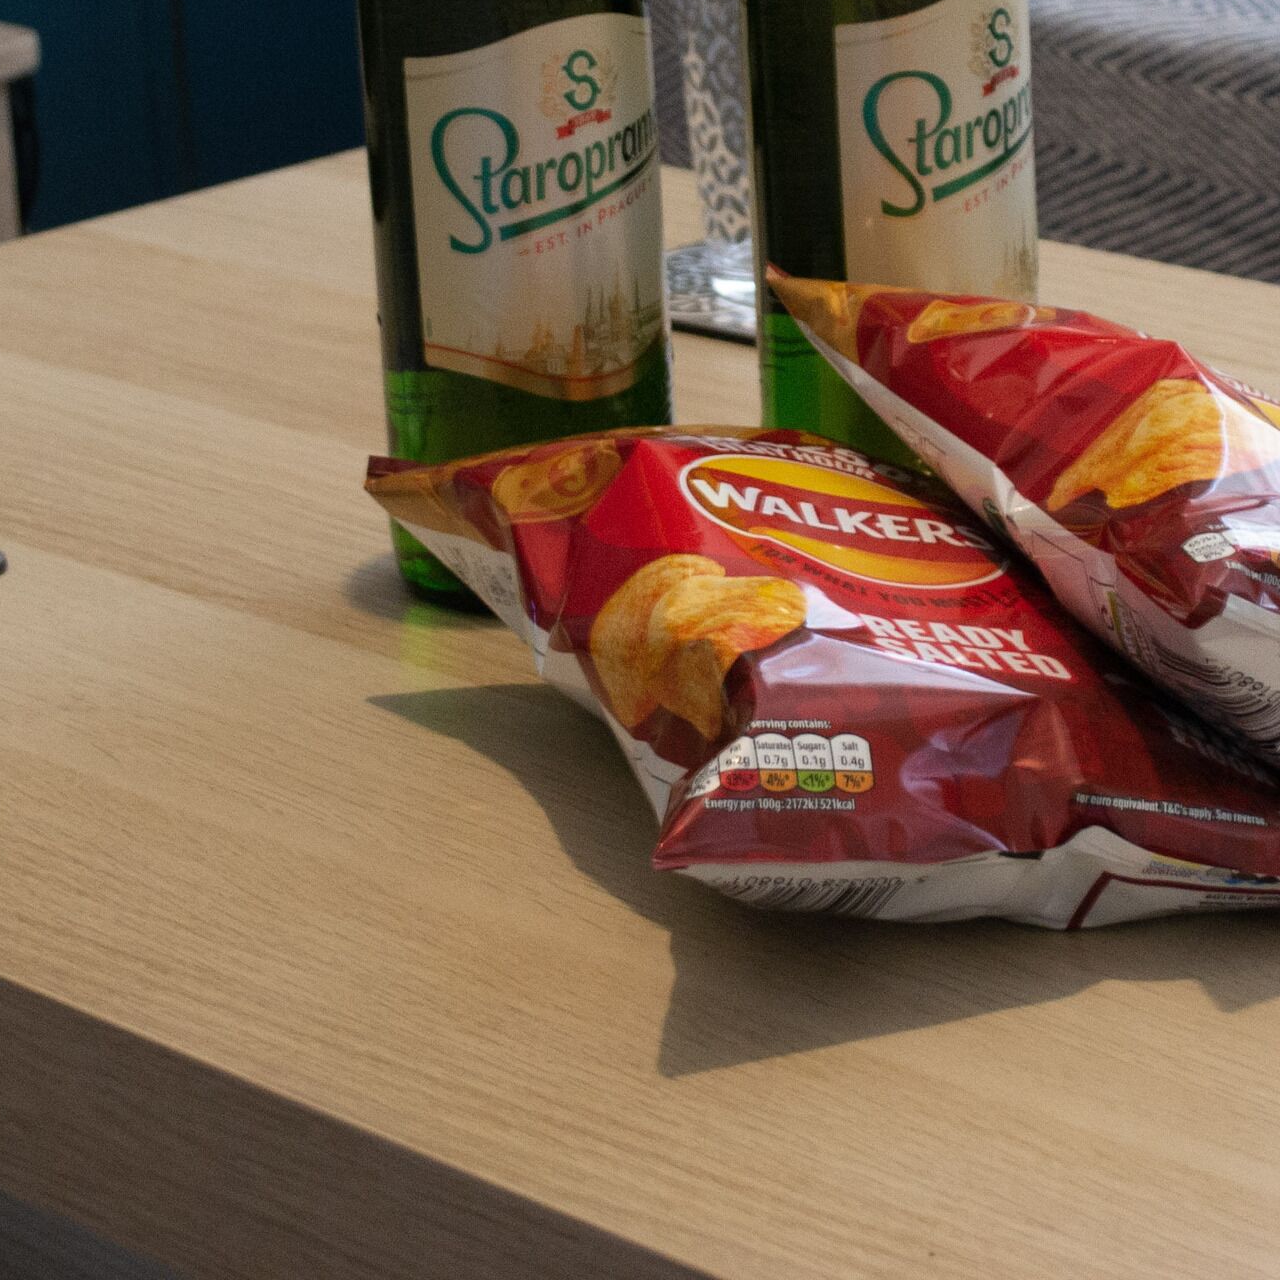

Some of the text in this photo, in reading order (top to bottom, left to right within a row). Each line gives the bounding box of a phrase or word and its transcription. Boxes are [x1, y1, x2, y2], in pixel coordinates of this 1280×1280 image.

[988, 8, 1013, 67] S
[562, 49, 601, 111] S
[577, 221, 593, 237] IN
[689, 477, 994, 552] WALKERS
[859, 614, 1032, 652] READY
[874, 637, 1074, 681] SALTED
[751, 719, 832, 731] serving contains:
[756, 741, 792, 750] Saturates
[797, 741, 826, 751] Sugars
[841, 741, 859, 750] Salt
[764, 755, 788, 767] 0.7g
[802, 755, 826, 767] 0.1g
[841, 756, 865, 768] 0.4g
[704, 798, 738, 811] Energy
[740, 799, 756, 810] per
[758, 798, 784, 811] 100g:
[820, 797, 856, 810] 521kcal
[1090, 794, 1112, 805] euro
[1163, 800, 1188, 815] T&C's
